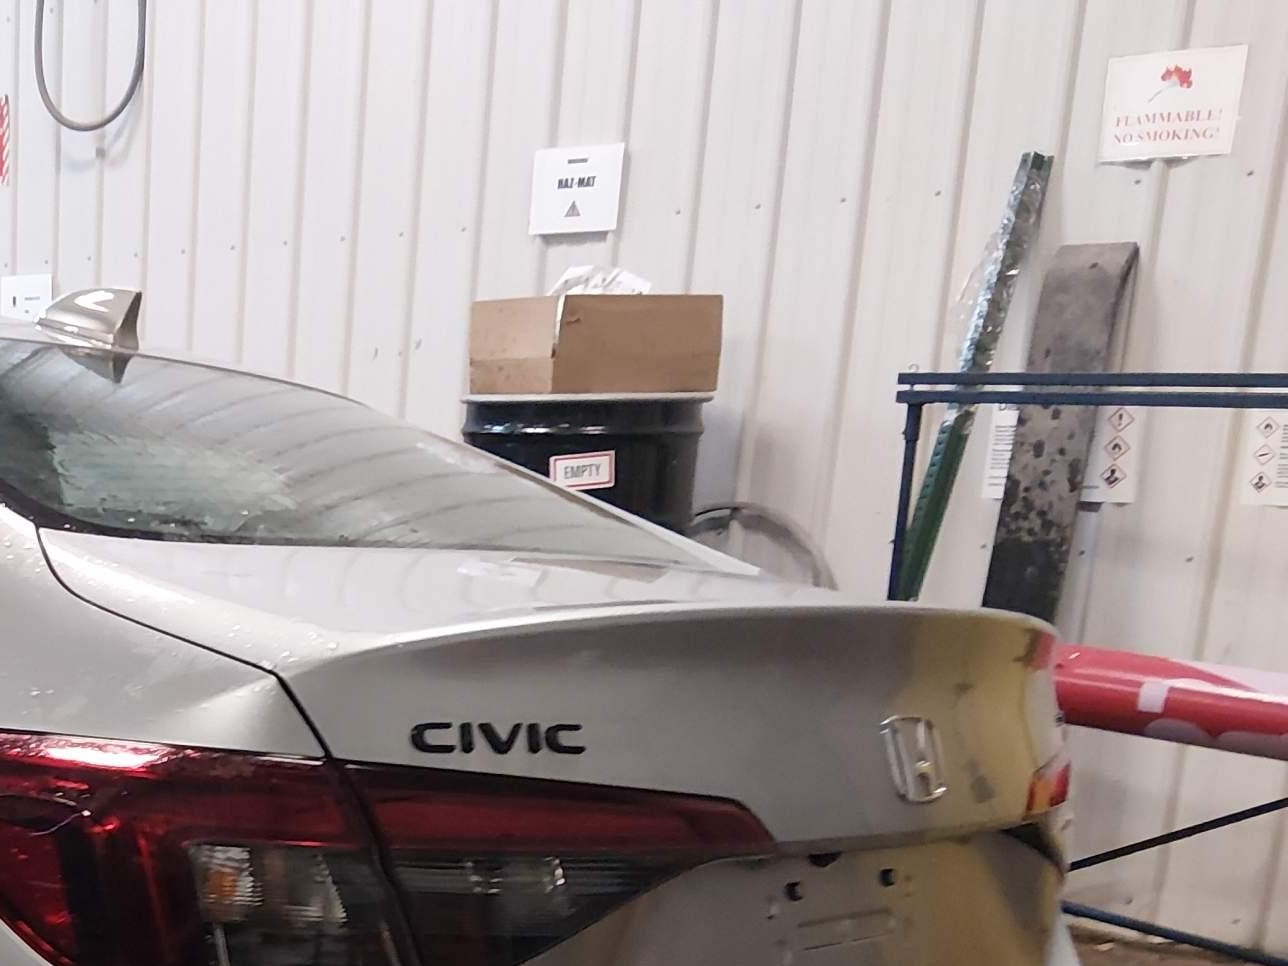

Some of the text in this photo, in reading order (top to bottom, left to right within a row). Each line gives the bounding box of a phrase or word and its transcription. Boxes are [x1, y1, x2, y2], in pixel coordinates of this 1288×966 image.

[1115, 108, 1223, 127] FLAMMABLE!
[1113, 127, 1220, 144] NO SMOKING!
[558, 176, 596, 189] HAZ-MAT
[564, 463, 601, 479] EMPTY
[411, 722, 586, 755] CIVIC
